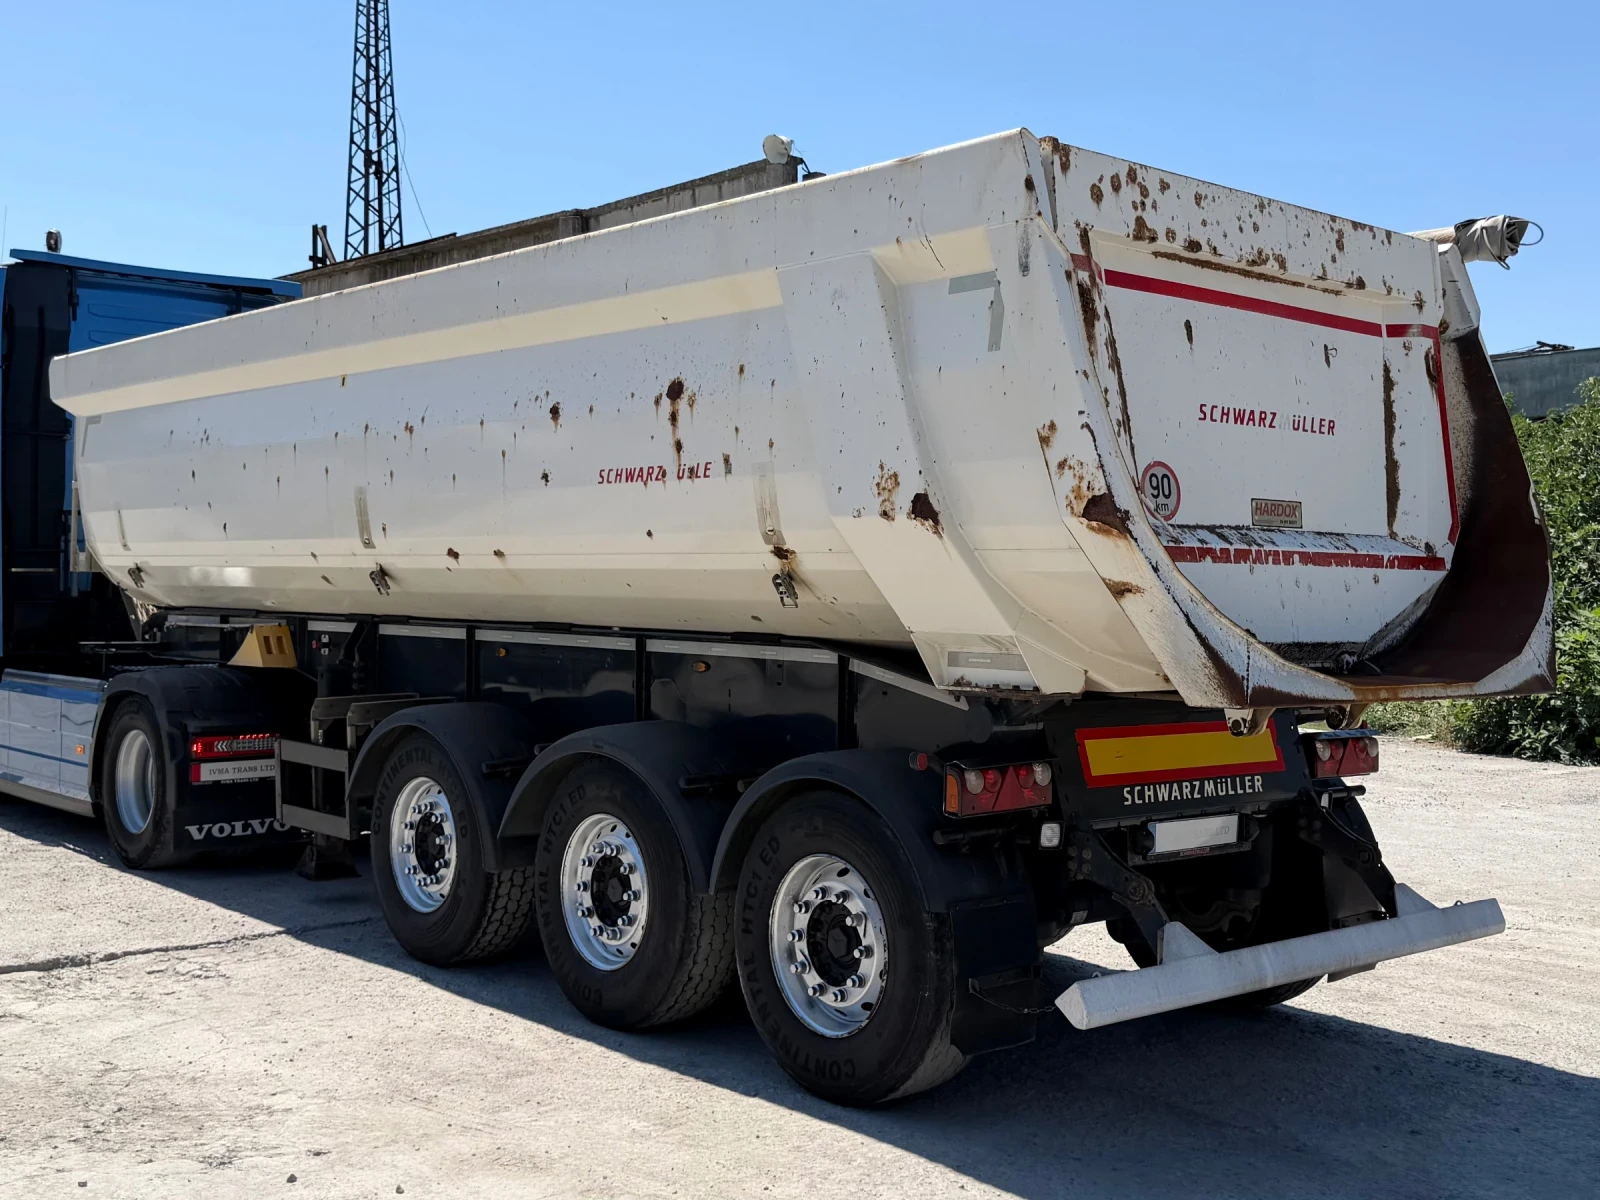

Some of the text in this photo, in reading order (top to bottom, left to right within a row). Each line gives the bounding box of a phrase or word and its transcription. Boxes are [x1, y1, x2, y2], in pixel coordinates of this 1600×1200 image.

[1149, 473, 1172, 499] 90
[1155, 500, 1170, 512] km
[1254, 502, 1299, 519] HARDOX
[209, 764, 276, 776] IVMA TRANS LTD
[568, 783, 587, 805] ED
[1123, 775, 1263, 805] SCHWARZMÜLLER
[184, 818, 292, 841] VOLVO
[742, 863, 761, 936] HTC1
[758, 835, 781, 867] ED
